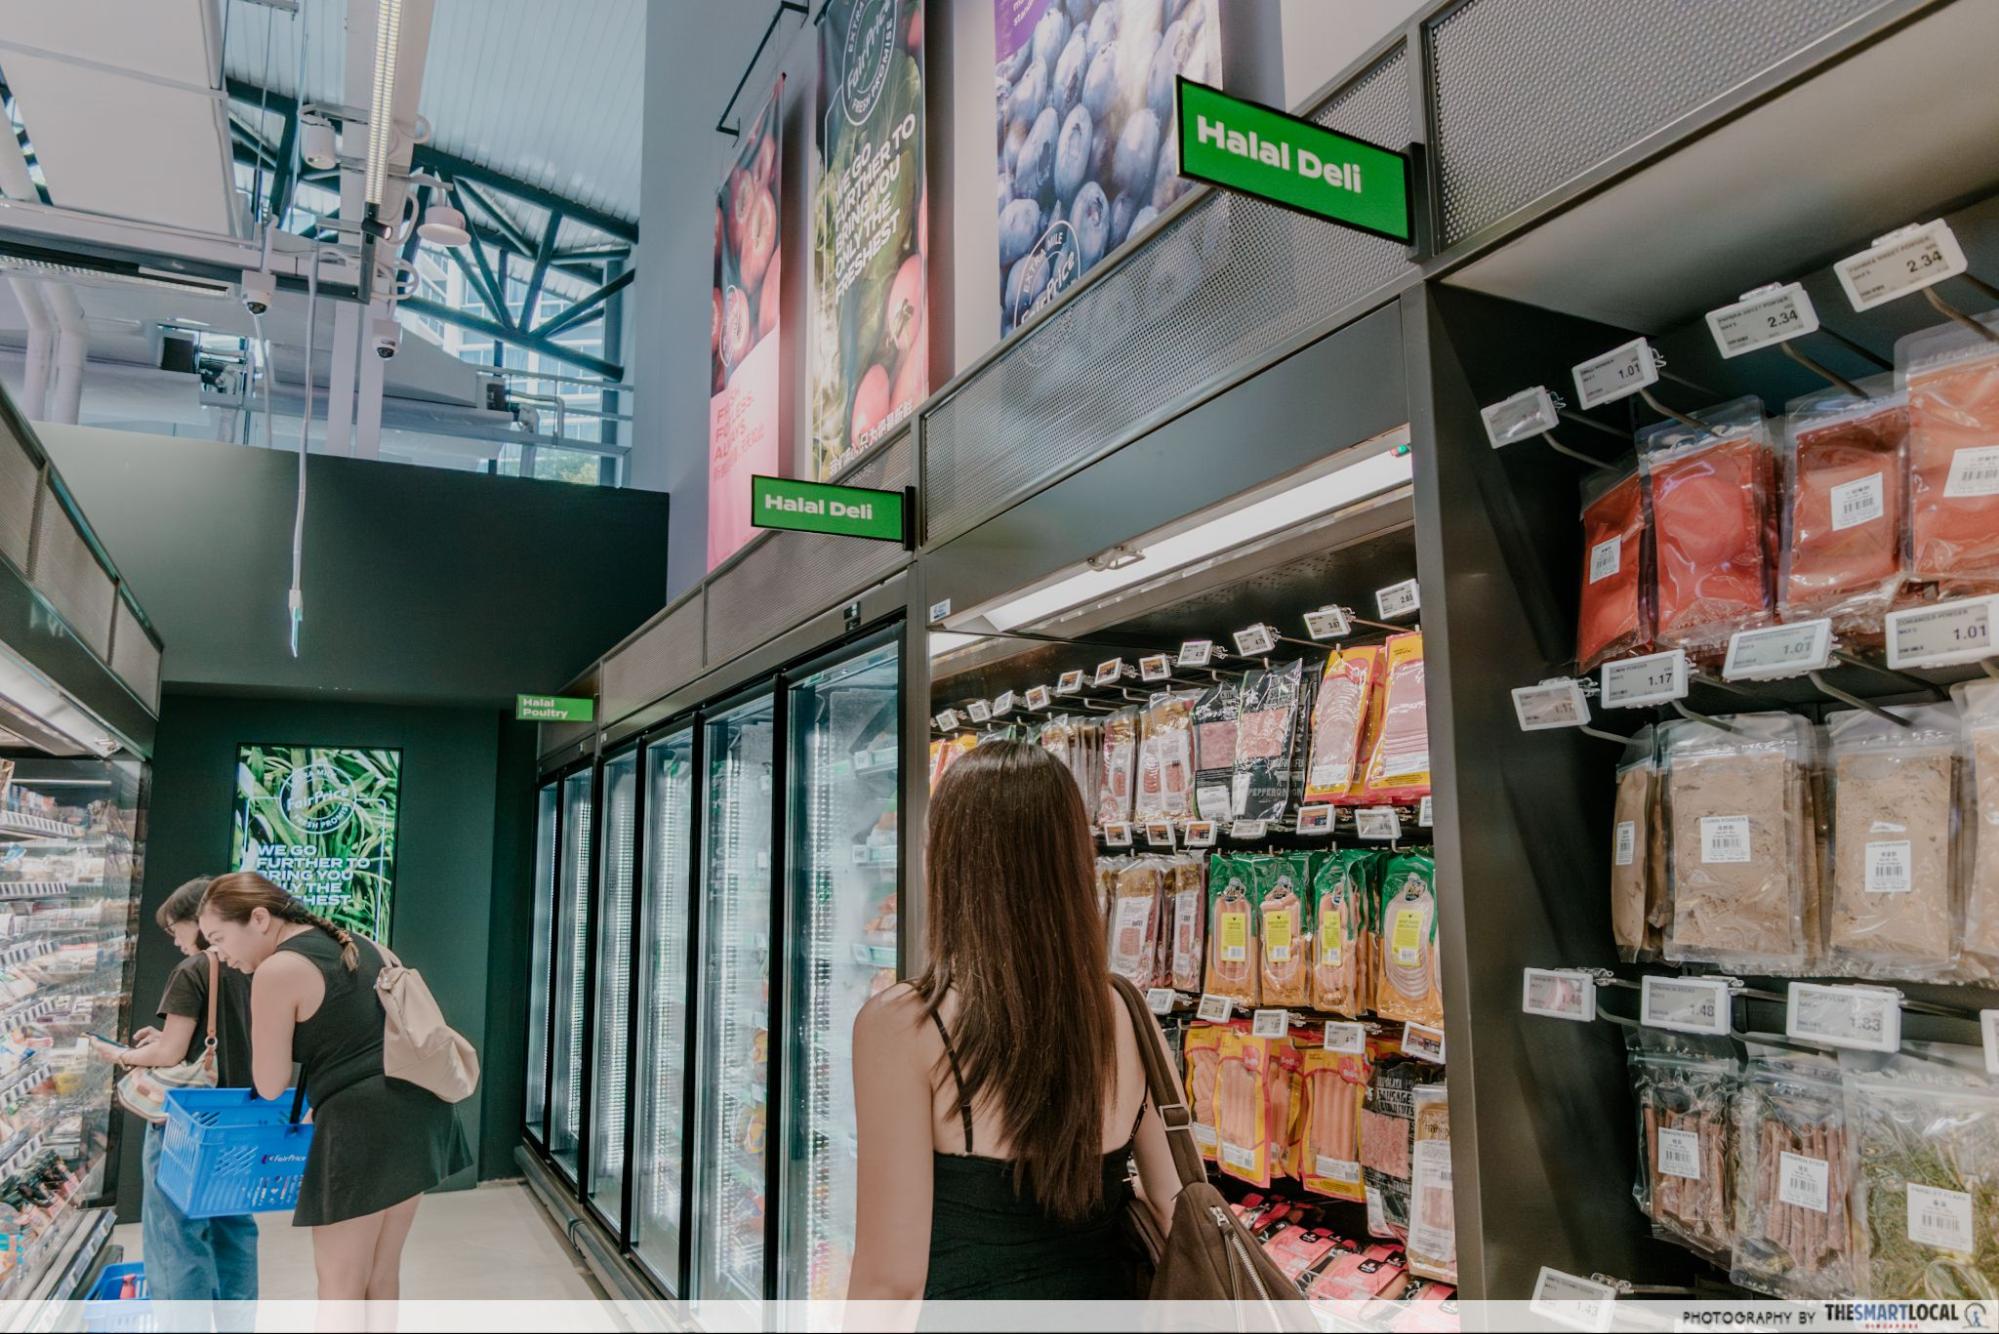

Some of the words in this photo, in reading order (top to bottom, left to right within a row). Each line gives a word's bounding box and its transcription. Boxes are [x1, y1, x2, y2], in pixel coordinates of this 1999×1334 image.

[852, 142, 871, 178] GO
[1197, 114, 1291, 171] Halal
[1297, 148, 1362, 194] Deli
[835, 141, 890, 231] FURTHER
[892, 113, 916, 148] TO
[835, 201, 869, 257] BRING
[871, 155, 901, 200] YOU
[836, 228, 863, 279] ONLY
[864, 192, 892, 238] THE
[836, 208, 901, 304] FRESHEST
[1906, 250, 1943, 273] 2.34
[1767, 310, 1798, 328] 2.34
[1618, 362, 1641, 380] 1.01
[765, 494, 825, 515] Halal
[829, 501, 873, 520] Deli
[1953, 624, 1988, 640] 1.01
[1783, 641, 1812, 655] 1.01
[1648, 673, 1673, 687] 1.17
[523, 698, 555, 708] Halal
[523, 707, 569, 719] Poultry
[258, 844, 287, 856] WE
[290, 844, 318, 856] GO
[256, 857, 343, 869] FURTHER
[345, 857, 371, 869] TO
[317, 870, 354, 881] YOU
[306, 882, 342, 893] THE
